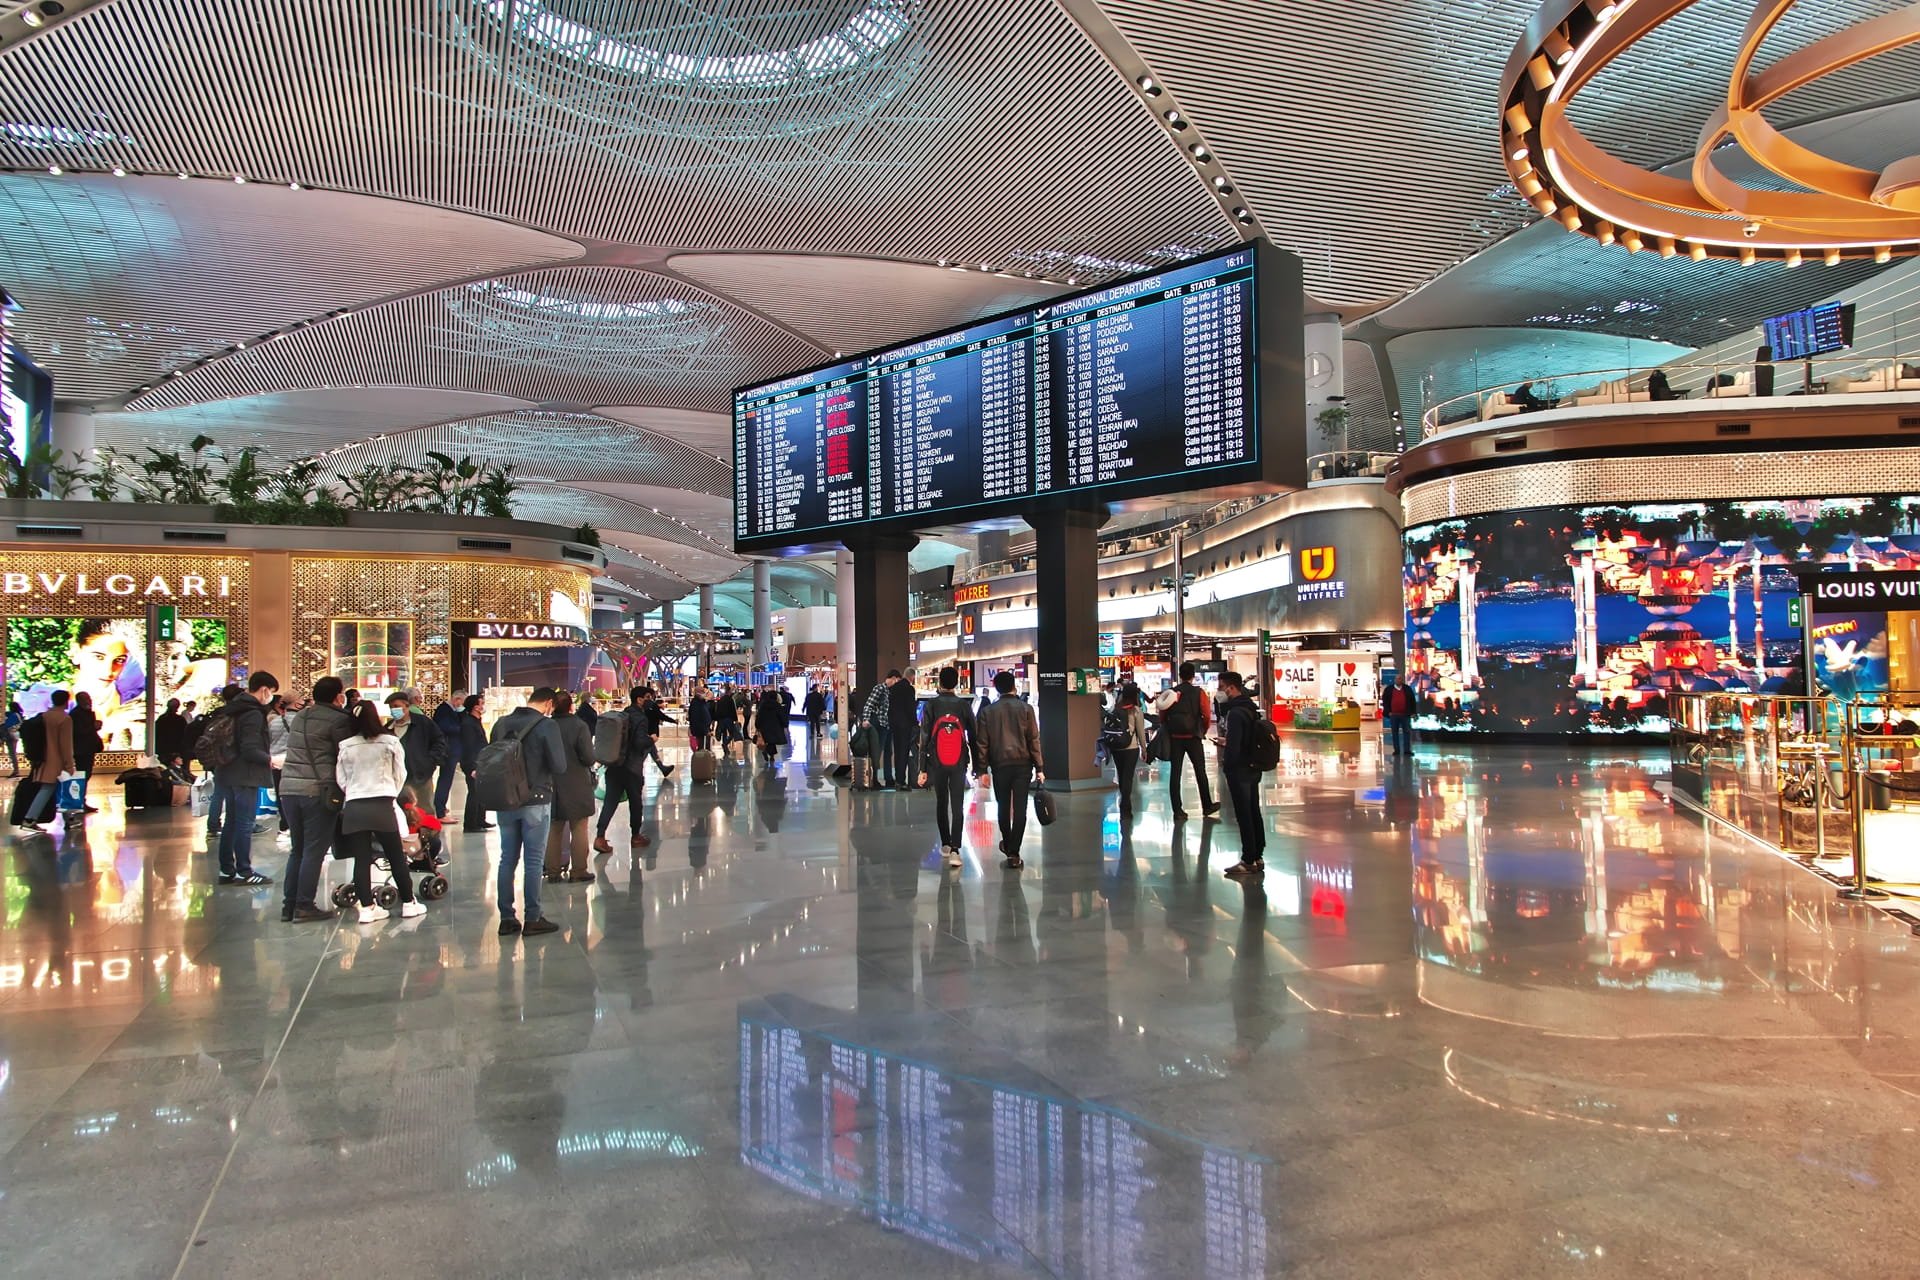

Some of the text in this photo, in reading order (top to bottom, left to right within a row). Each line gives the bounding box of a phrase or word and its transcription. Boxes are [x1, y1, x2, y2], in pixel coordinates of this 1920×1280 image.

[1052, 256, 1243, 316] INTERNATIONAL DEPARTURES 16:11
[1035, 278, 1216, 334] TIME EST. FLIGHT DESTINATION GATE STATUS
[1097, 283, 1240, 329] ABU DHABI Gate Info 18:15
[1097, 294, 1241, 339] PODGORICA Gate Info 18:15
[1098, 304, 1241, 348] TIRANA Gate Info 18:20
[881, 317, 1027, 364] INTERNATIONAL DEPARTURES 16:11
[1097, 343, 1129, 357] SARAJEVO
[1183, 325, 1198, 336] Gate
[1199, 322, 1211, 332] Info
[1224, 314, 1241, 326] 18:30
[1097, 325, 1241, 367] DUBAI Gate Info 18:35
[881, 335, 1007, 375] EST. FLIGHT DESTINATION GATE STATUS
[1097, 365, 1115, 376] SOFIA
[1184, 345, 1198, 356] Gate
[1200, 342, 1211, 352] Info
[1224, 335, 1241, 347] 18:55
[916, 366, 930, 376] CAIRO
[1098, 345, 1242, 386] KARACHI Gate Info 18:45
[1079, 356, 1242, 399] 0271 CHISINAU Gate Info 19:05
[1098, 366, 1242, 405] ARBIL Gate Info 19:15
[747, 375, 814, 399] INTERNATIONAL DEPARTURES
[816, 384, 826, 392] GATE
[840, 386, 852, 395] GATE
[916, 390, 934, 401] NIAMEY
[916, 398, 938, 409] MOSCOW
[1098, 377, 1242, 414] ODESA Gate Info 19:00
[827, 401, 855, 414] GATE CLOSED
[917, 406, 940, 417] MISURATA
[1098, 387, 1242, 424] LAHORE Gate Info 19:00
[917, 416, 931, 426] CAIRO
[1098, 397, 1243, 433] TEHRAN (IKA) Gate Info 19:00
[827, 425, 856, 437] GATE CLOSED
[917, 424, 933, 434] DHAKA
[1098, 408, 1243, 443] BEIRUT Gate Info 19:05
[917, 429, 952, 442] MOSCOW (SVO)
[1079, 418, 1243, 455] 0222 BAGHDAD Gate Info 19:25
[917, 441, 931, 450] TUNIS
[917, 448, 941, 459] TASHKENT
[1099, 429, 1243, 462] TBILISI Gate Info 19:15
[917, 459, 927, 467] DAR
[935, 454, 954, 464] SALAAM
[1099, 439, 1243, 471] KHARTOUM Gate Info 19:15
[1099, 450, 1244, 481] DOHA Gate Info 19:15
[842, 473, 853, 481] GATE
[917, 475, 931, 484] DUBAI
[918, 490, 943, 500] BELGRADE
[918, 500, 931, 508] DOHA
[3, 573, 229, 596] BVLGARI
[968, 584, 989, 600] FREE
[1297, 582, 1344, 593] UNIFREE
[1818, 582, 1876, 598] LOUIS
[478, 623, 570, 638] BVLGARI
[1124, 655, 1145, 666] FREE
[1285, 668, 1315, 682] SALE
[1337, 663, 1341, 676] I
[1336, 678, 1358, 687] SALE
